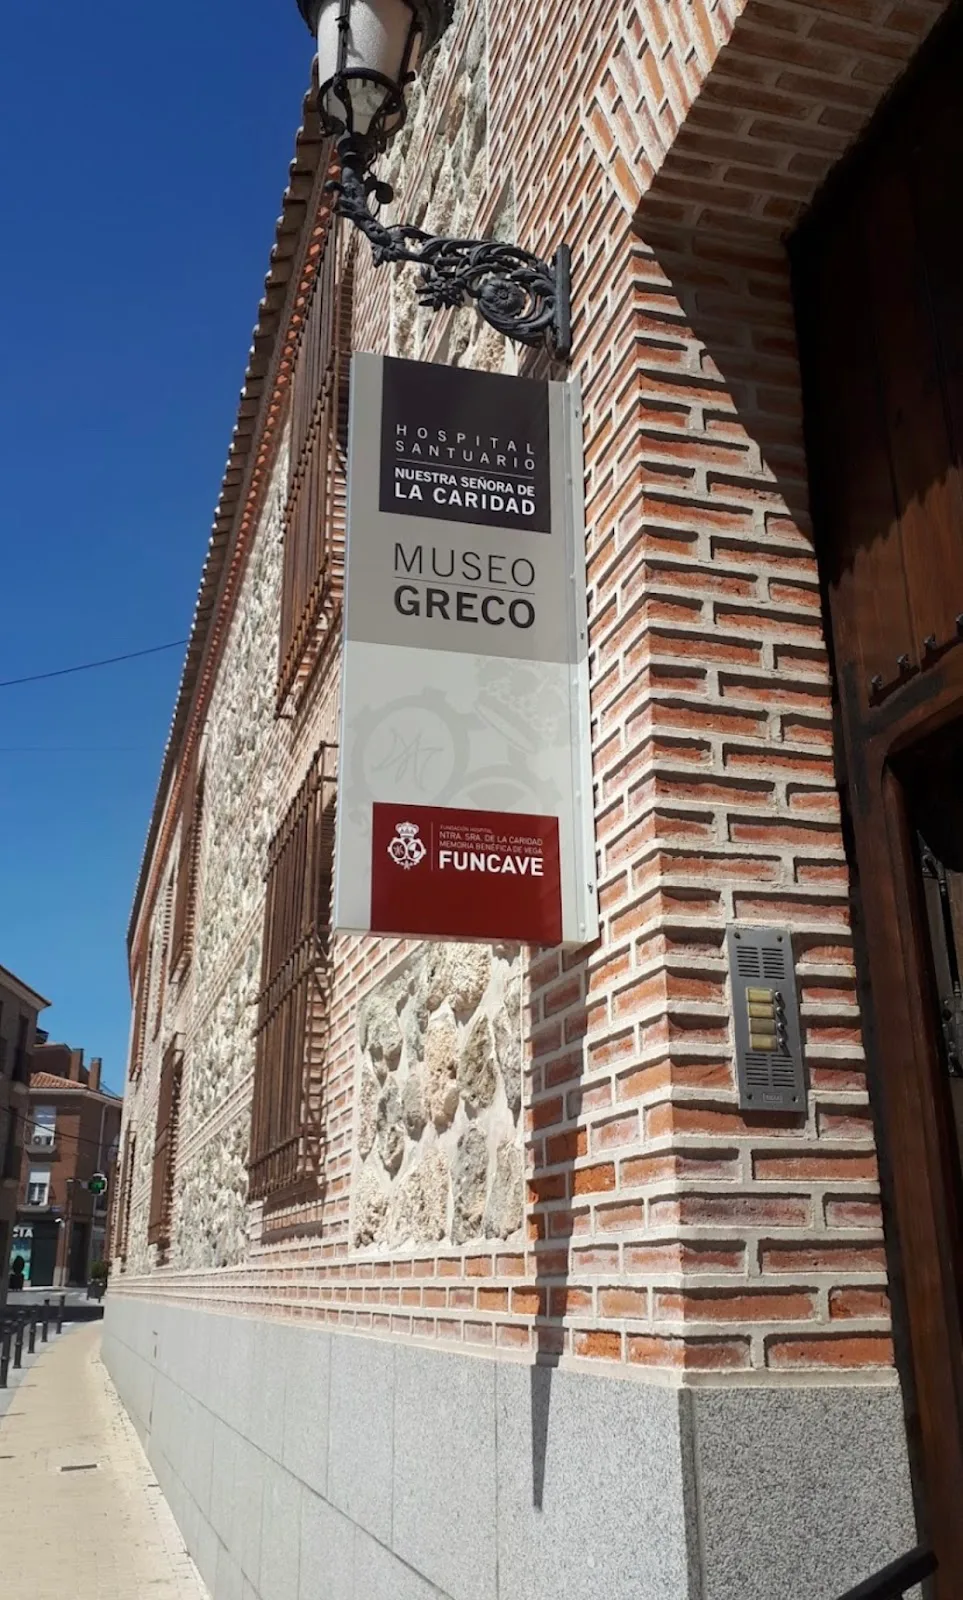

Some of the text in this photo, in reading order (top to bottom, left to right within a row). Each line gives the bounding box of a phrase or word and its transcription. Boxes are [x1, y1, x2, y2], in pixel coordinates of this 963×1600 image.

[396, 424, 535, 455] HOSPITAL
[395, 440, 535, 470] SANTUARIO
[395, 467, 535, 497] NUESTRA SEÑORA DE
[395, 482, 536, 516] LA CARIDAD
[394, 542, 535, 587] MUSEO
[394, 585, 535, 629] GRECO
[439, 840, 474, 850] MEMORIA
[513, 845, 522, 853] DE
[524, 846, 543, 855] VEGA
[484, 834, 495, 843] DE
[497, 836, 507, 844] LA
[509, 836, 543, 847] CARIDAD
[439, 850, 544, 877] FUNCAVE
